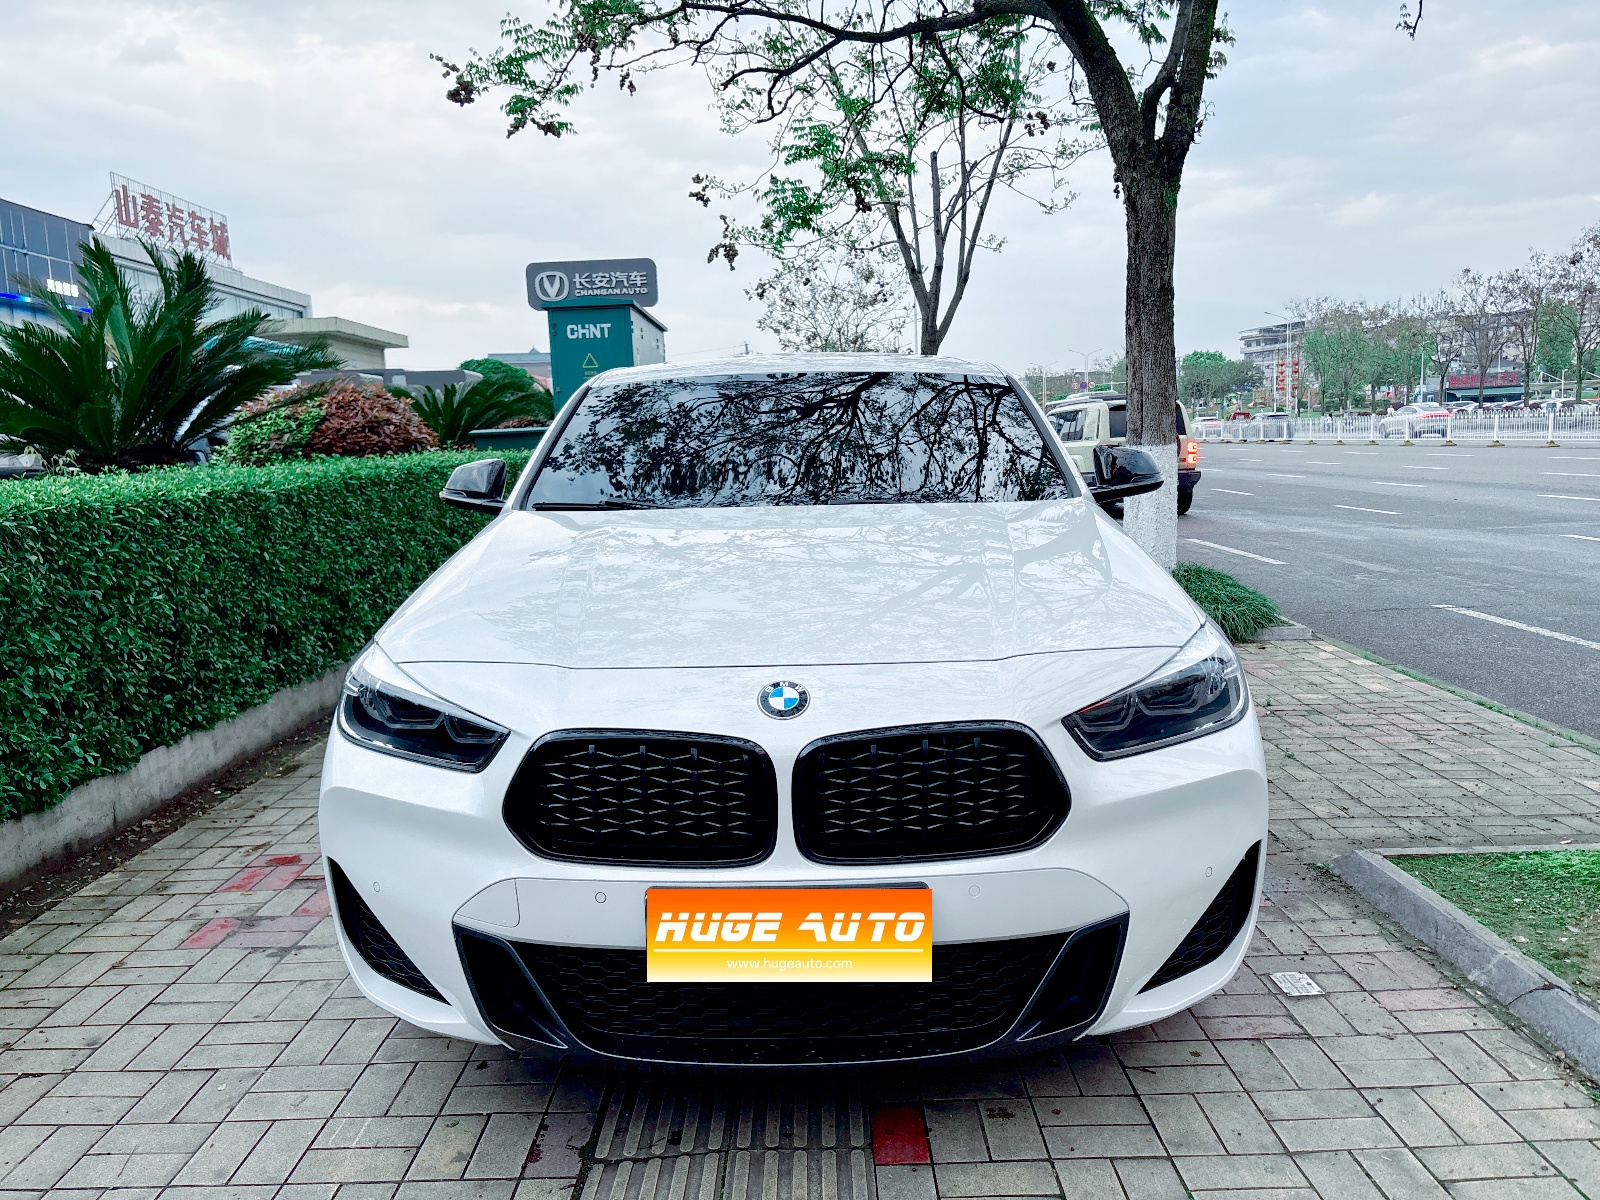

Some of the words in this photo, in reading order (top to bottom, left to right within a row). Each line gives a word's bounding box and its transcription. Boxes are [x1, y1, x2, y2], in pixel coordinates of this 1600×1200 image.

[115, 184, 231, 260] 山泰汽车城
[573, 271, 648, 289] 长安汽车
[574, 289, 621, 297] CHANGAN
[621, 287, 648, 295] AUTO
[566, 323, 612, 339] CHNT
